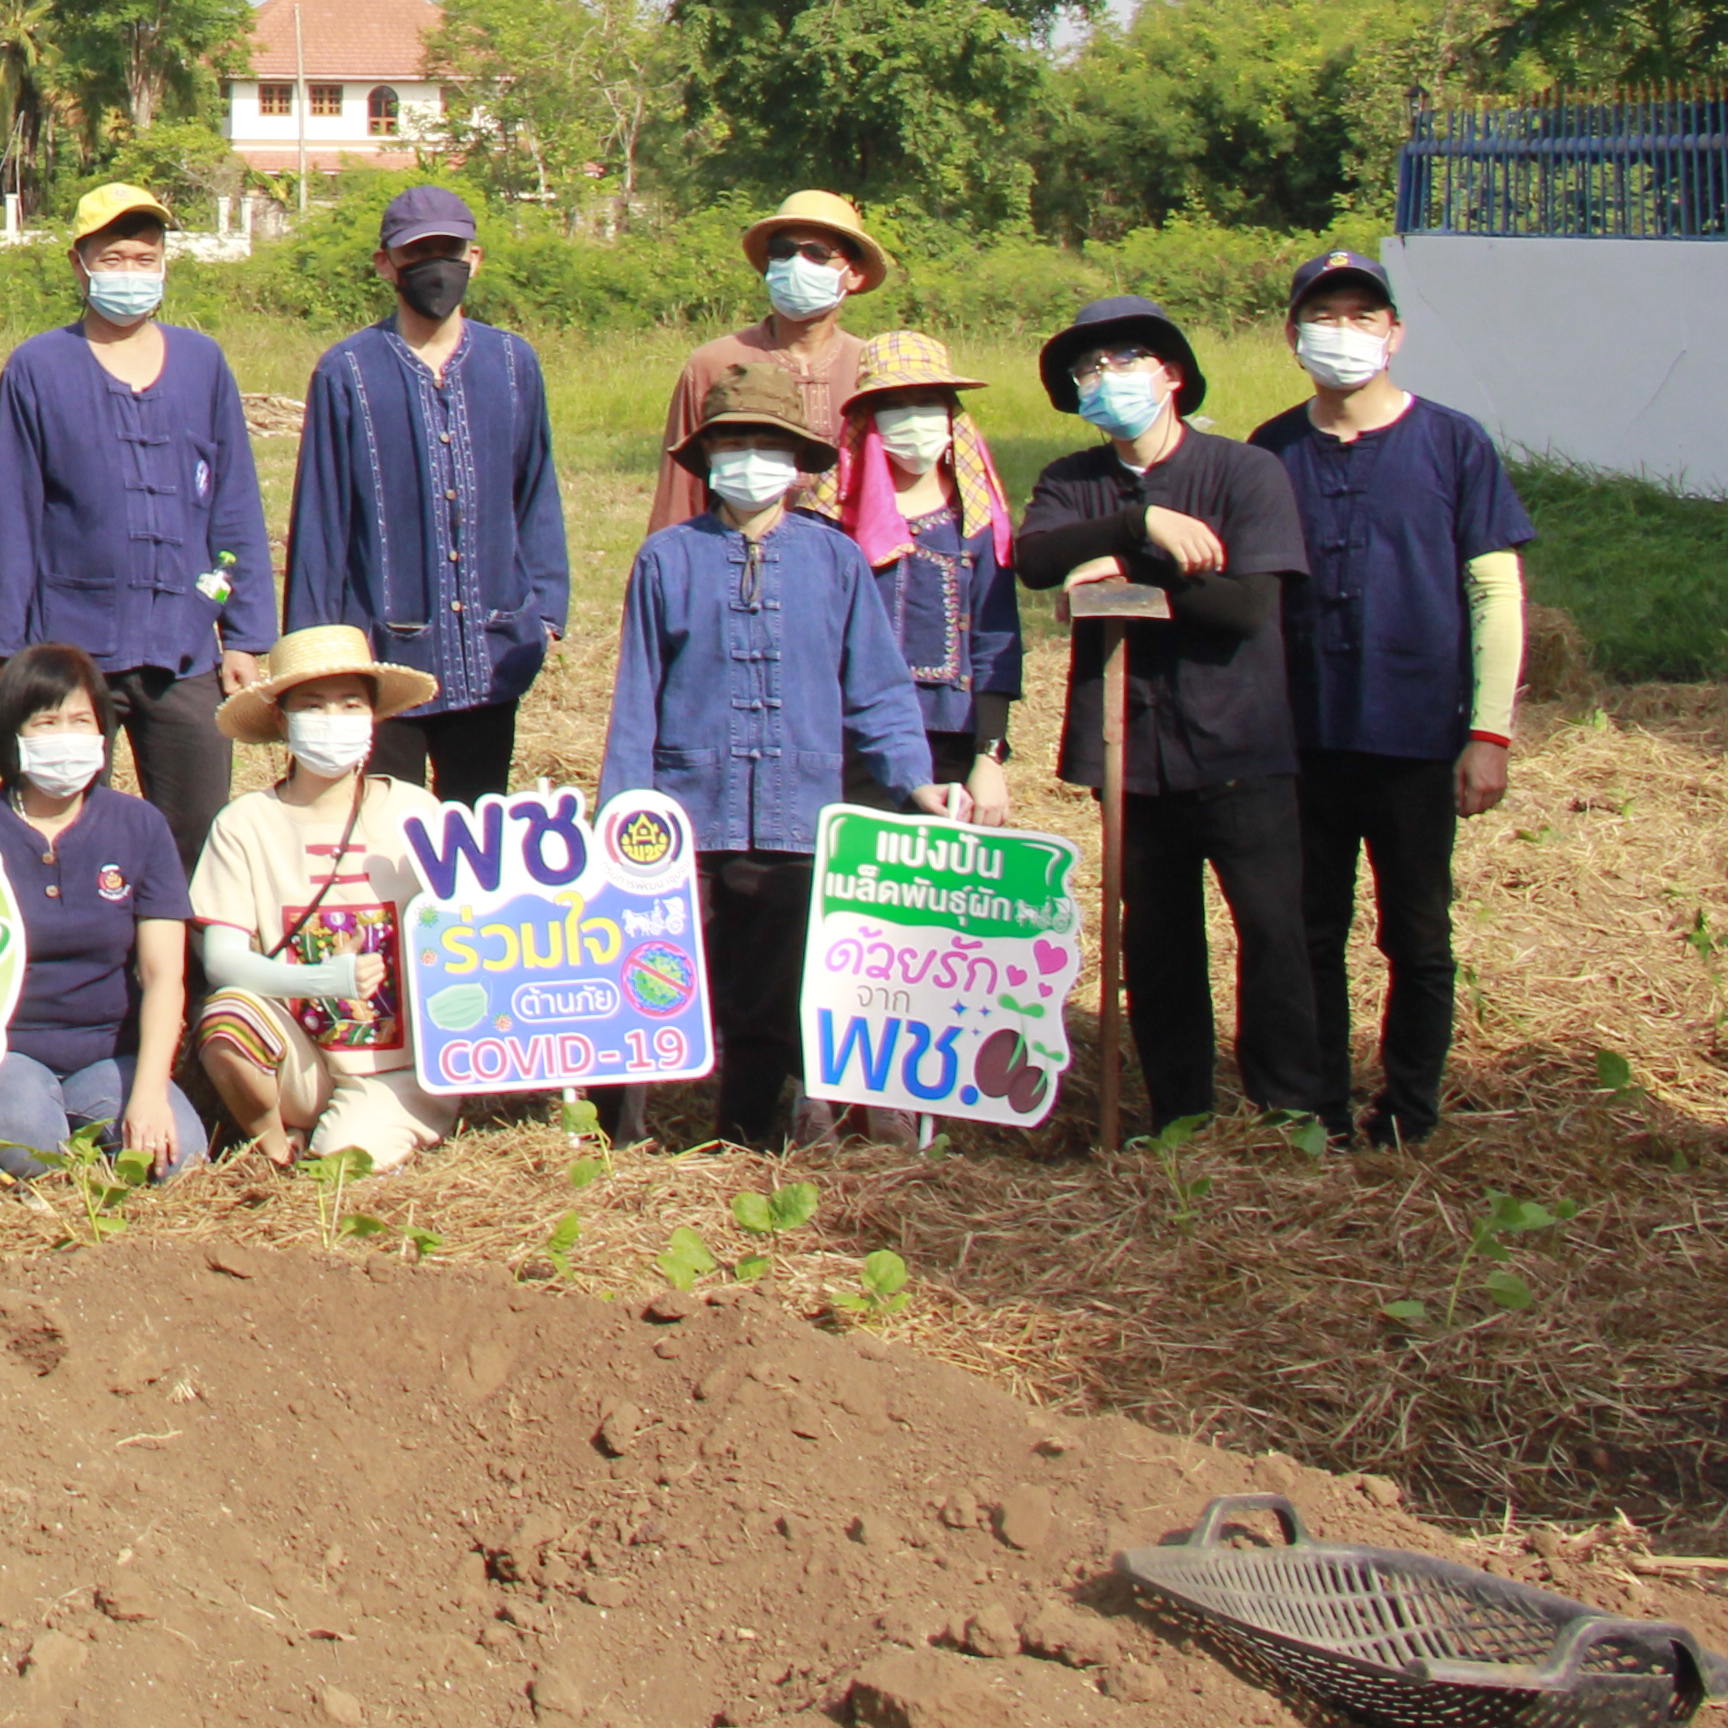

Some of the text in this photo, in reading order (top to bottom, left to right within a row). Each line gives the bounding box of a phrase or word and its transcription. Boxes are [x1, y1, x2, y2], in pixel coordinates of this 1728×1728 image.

[403, 794, 587, 900] พช
[876, 827, 1005, 880] แบ่งปัน
[825, 865, 1012, 927] เมล็ดพันธุ์ผัก
[441, 891, 622, 974] ร่วมใจ
[825, 926, 998, 994] ด้วยรัก
[520, 985, 613, 1016] ต้านภัย
[856, 985, 911, 1013] จาก
[439, 1027, 687, 1085] COVID-19
[817, 1007, 979, 1105] พช.
